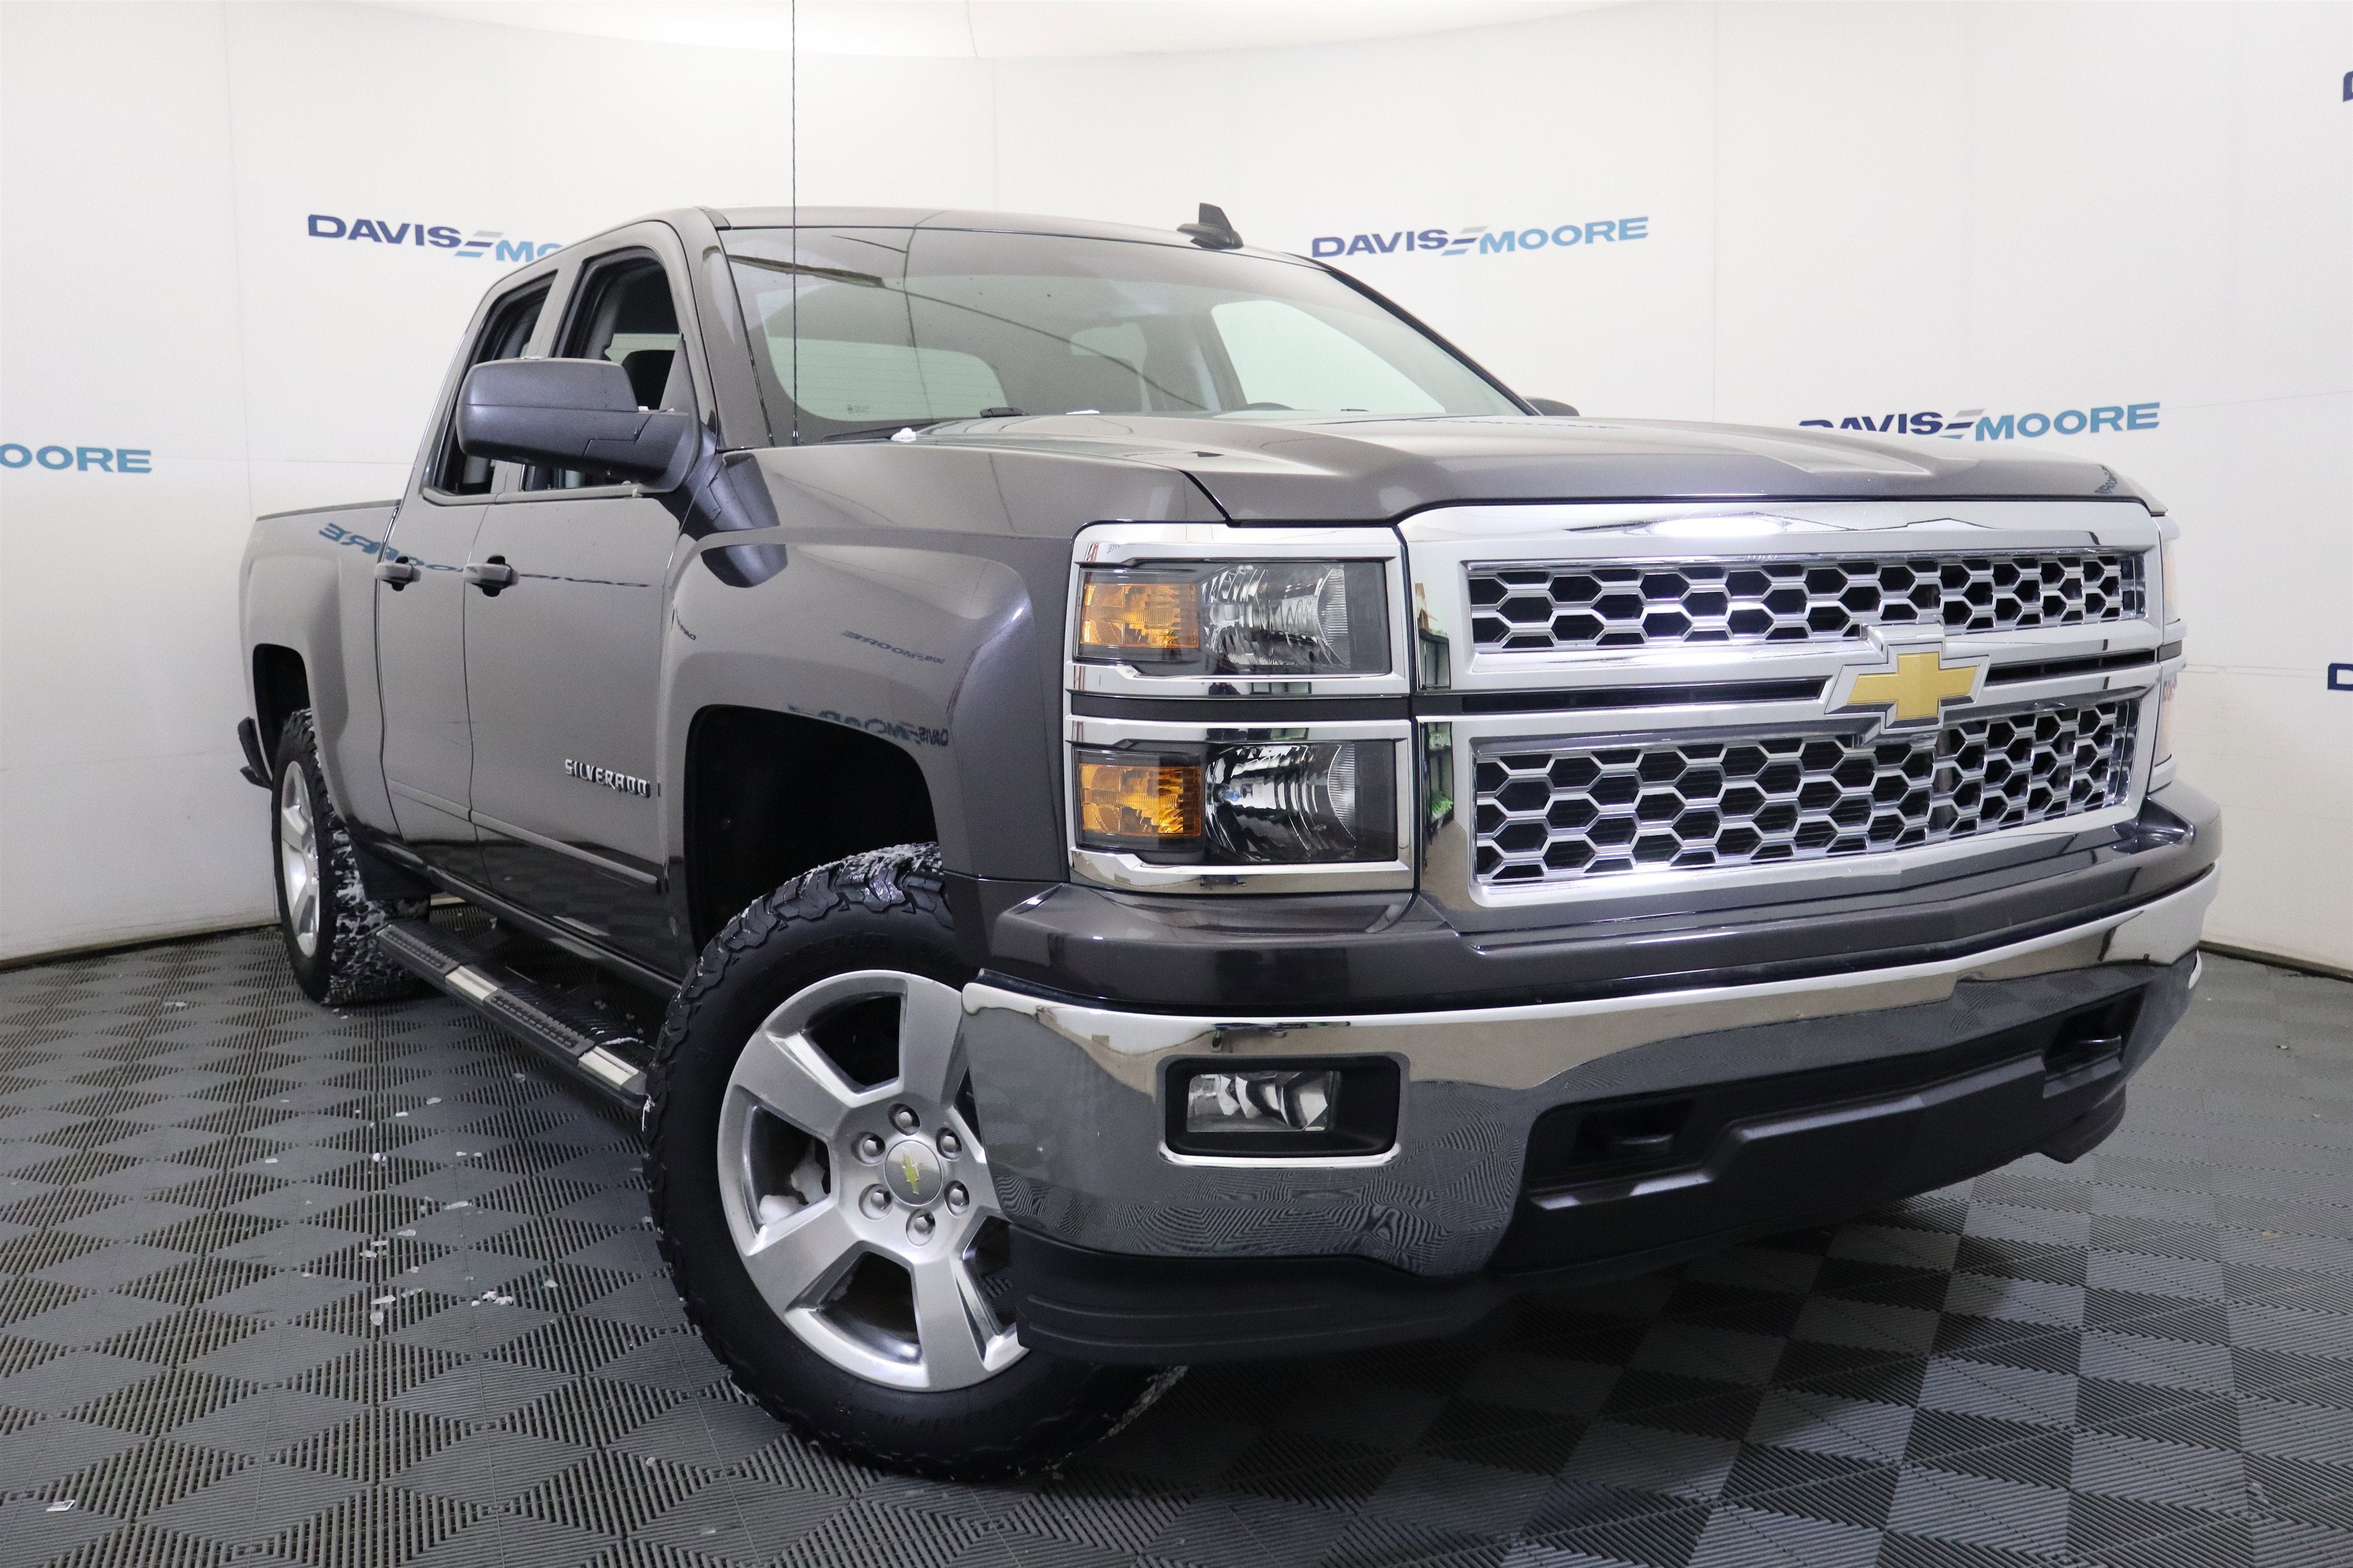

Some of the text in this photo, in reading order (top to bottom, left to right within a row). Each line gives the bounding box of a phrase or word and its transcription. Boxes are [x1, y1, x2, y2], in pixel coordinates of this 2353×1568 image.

[307, 215, 462, 249] DAVIS
[1311, 216, 1648, 258] DAVIS MOORE
[1975, 401, 2160, 442] MOORE
[0, 443, 152, 474] OORE
[564, 758, 651, 798] SILVERADO
